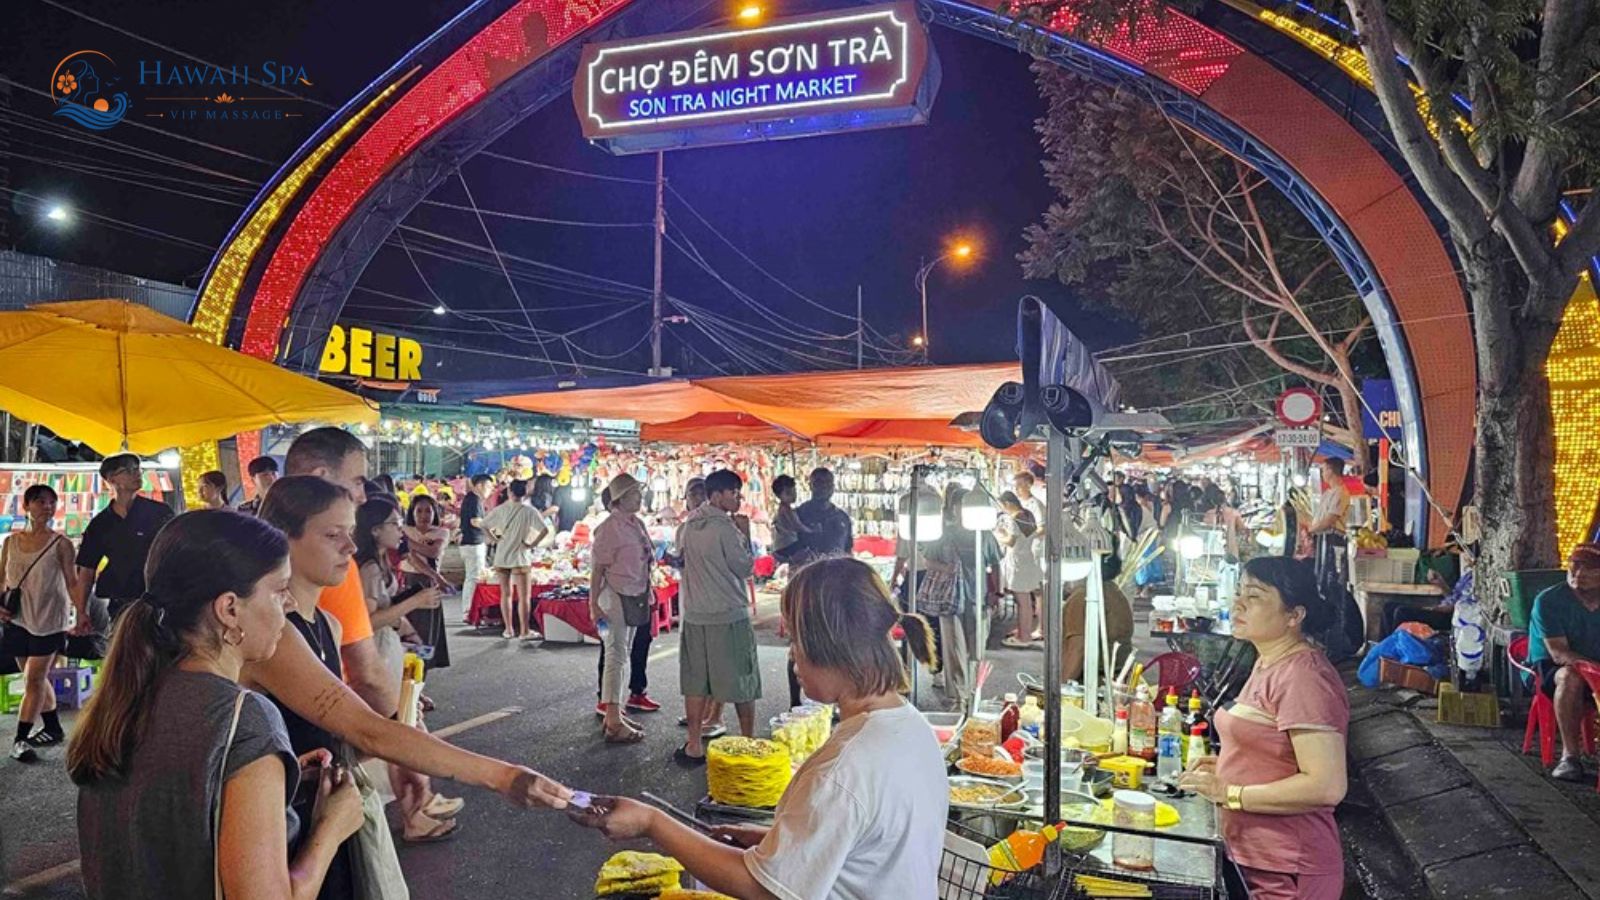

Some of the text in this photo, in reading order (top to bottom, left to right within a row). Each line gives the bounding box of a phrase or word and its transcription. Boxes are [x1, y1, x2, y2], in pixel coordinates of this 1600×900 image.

[600, 26, 893, 95] CHỢ ĐÊM SƠN TRÀ
[629, 74, 857, 117] SON TRA NIGHT MARKET
[319, 324, 423, 381] BEER
